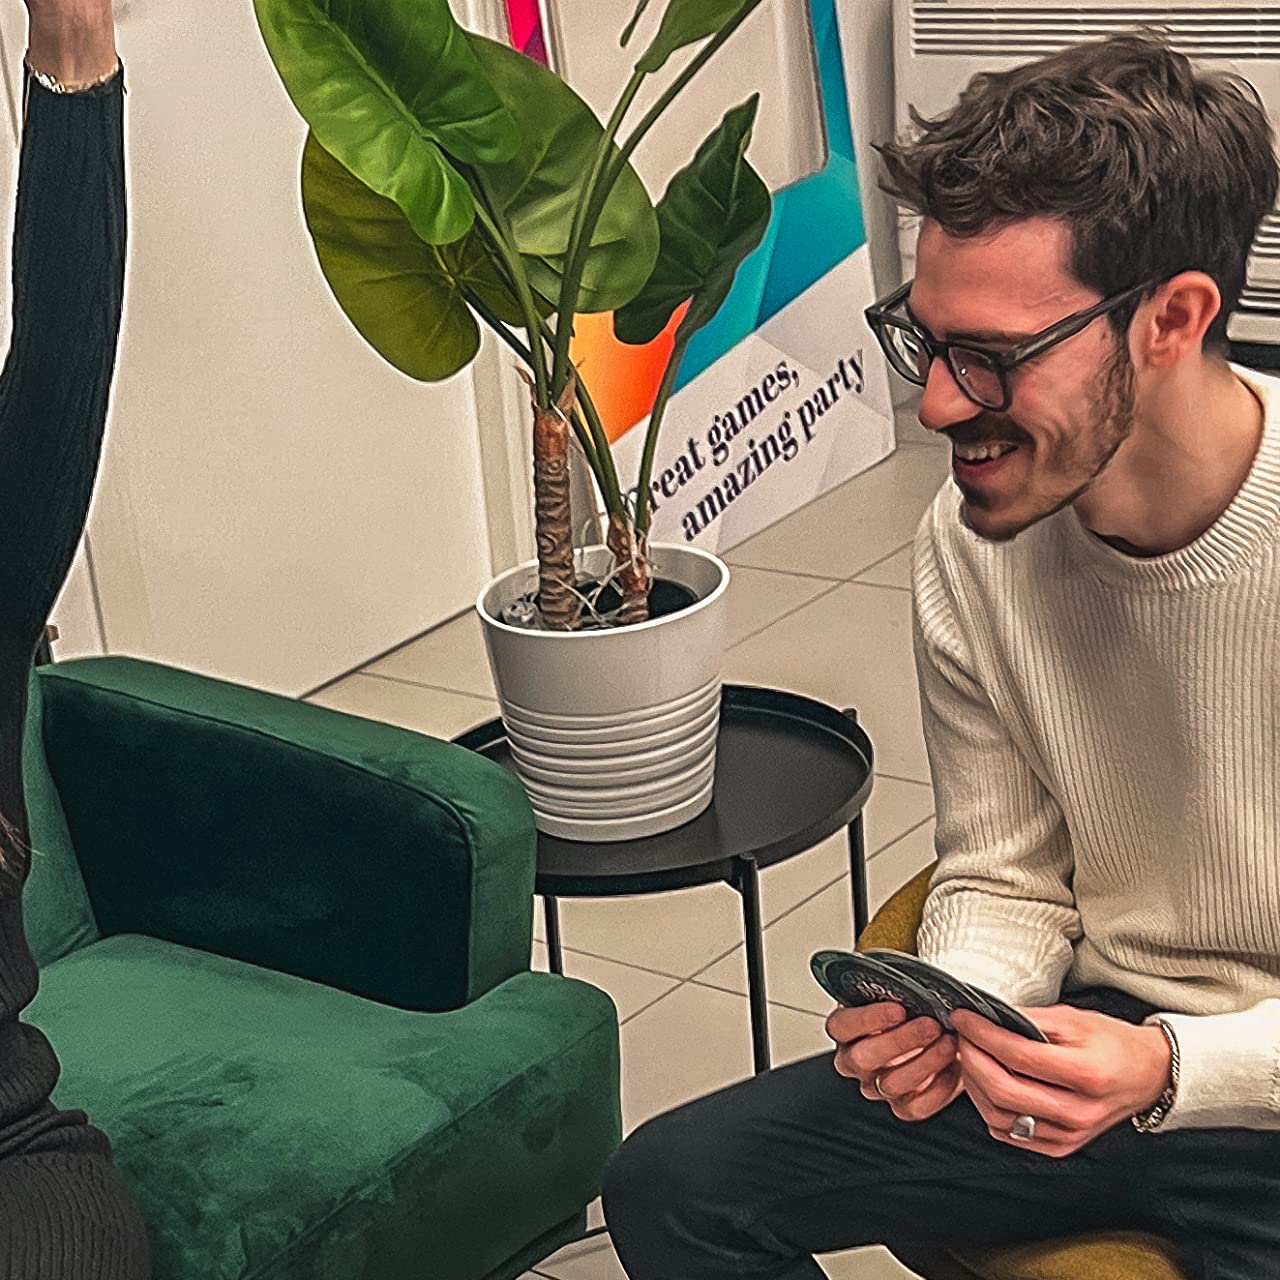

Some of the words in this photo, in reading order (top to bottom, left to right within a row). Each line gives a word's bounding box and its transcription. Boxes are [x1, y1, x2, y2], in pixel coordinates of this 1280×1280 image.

[681, 411, 800, 542] amazing
[797, 348, 866, 443] party
[708, 360, 800, 467] games,
